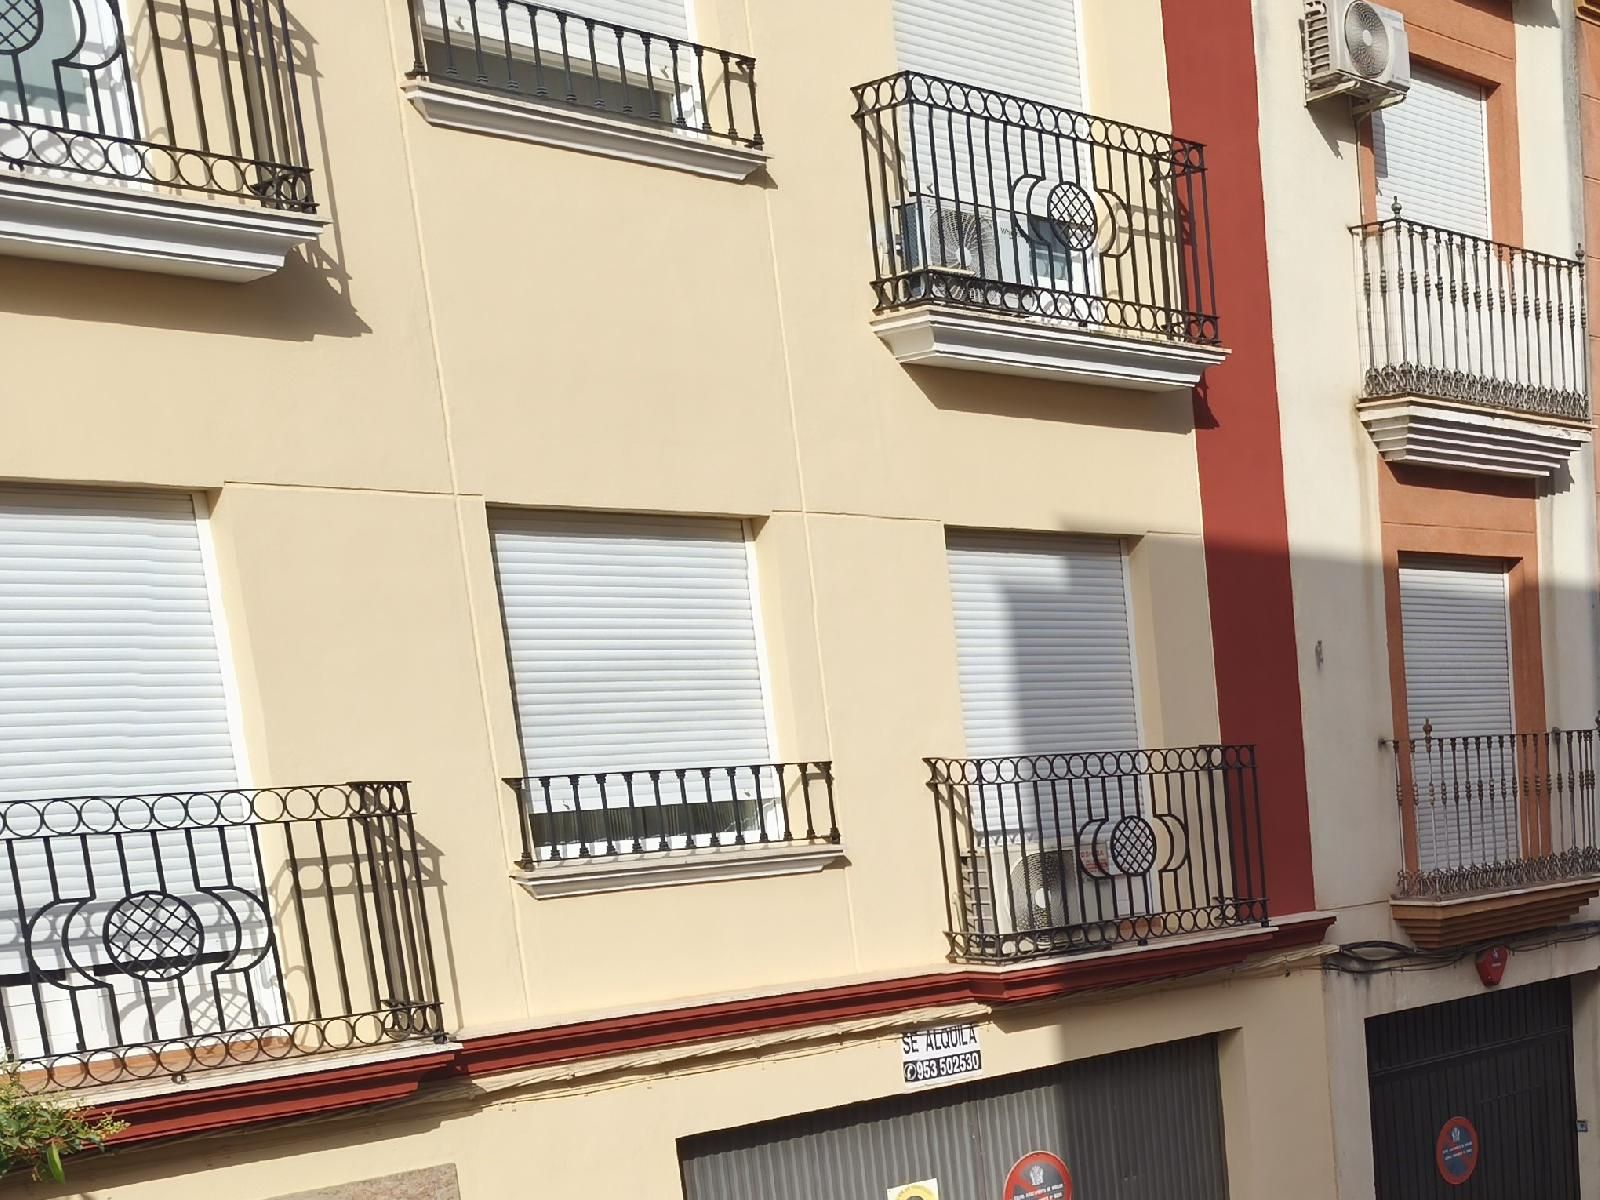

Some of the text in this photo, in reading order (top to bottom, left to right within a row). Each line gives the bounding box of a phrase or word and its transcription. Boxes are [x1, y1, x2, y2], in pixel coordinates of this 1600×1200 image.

[902, 1024, 977, 1054] SE ALQUILA
[916, 1053, 979, 1080] 953 502530
